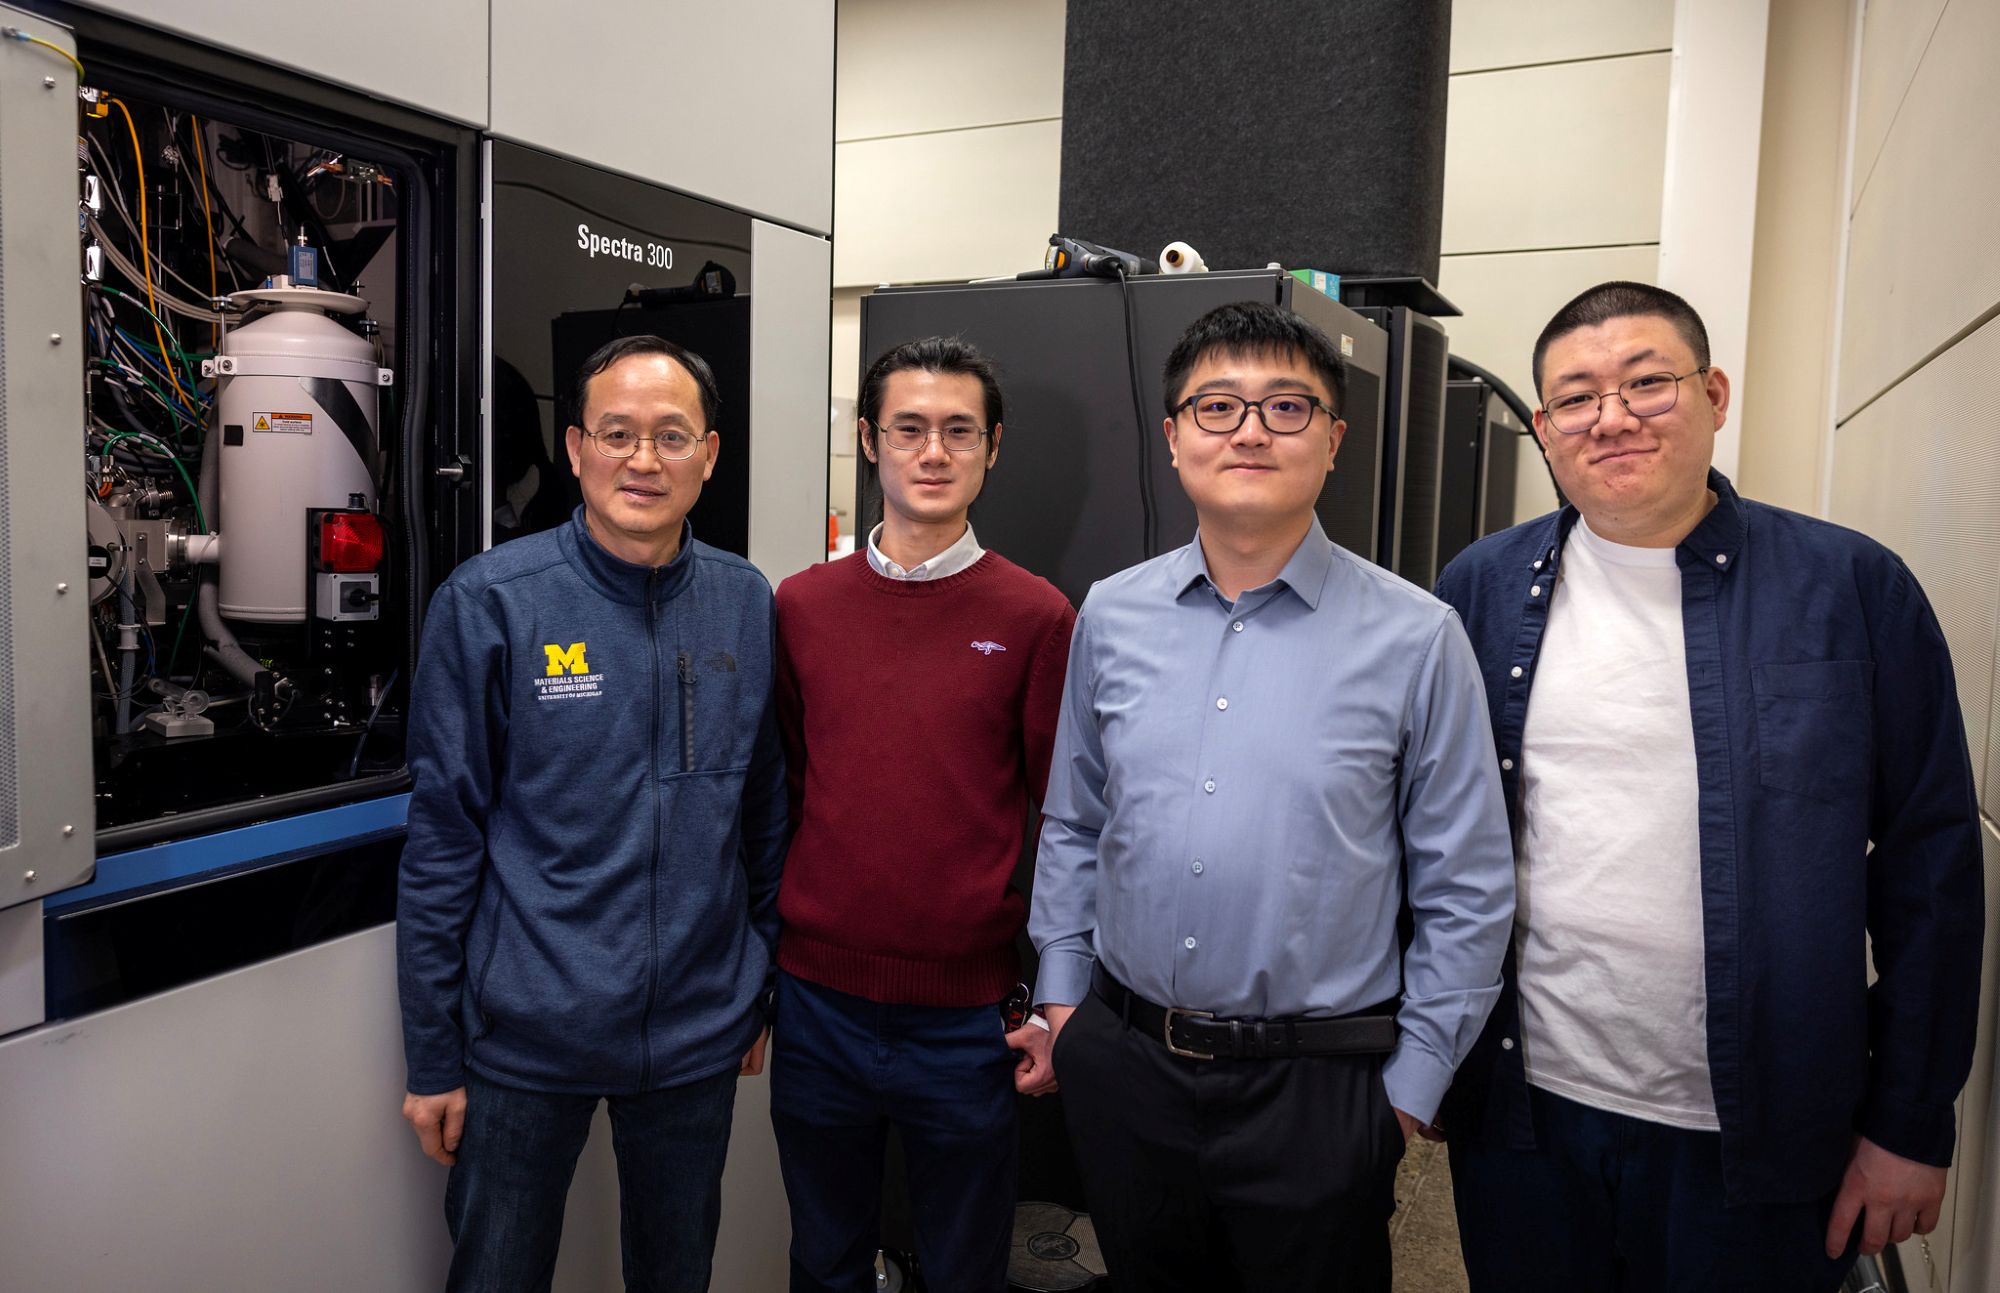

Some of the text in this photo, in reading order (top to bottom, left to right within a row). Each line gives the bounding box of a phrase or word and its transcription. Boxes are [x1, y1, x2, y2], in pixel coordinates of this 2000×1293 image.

[577, 224, 673, 270] Spectra 300
[544, 642, 589, 676] M
[534, 674, 604, 686] MATERIALS SCIENCE
[541, 683, 597, 694] & ENGINEERING
